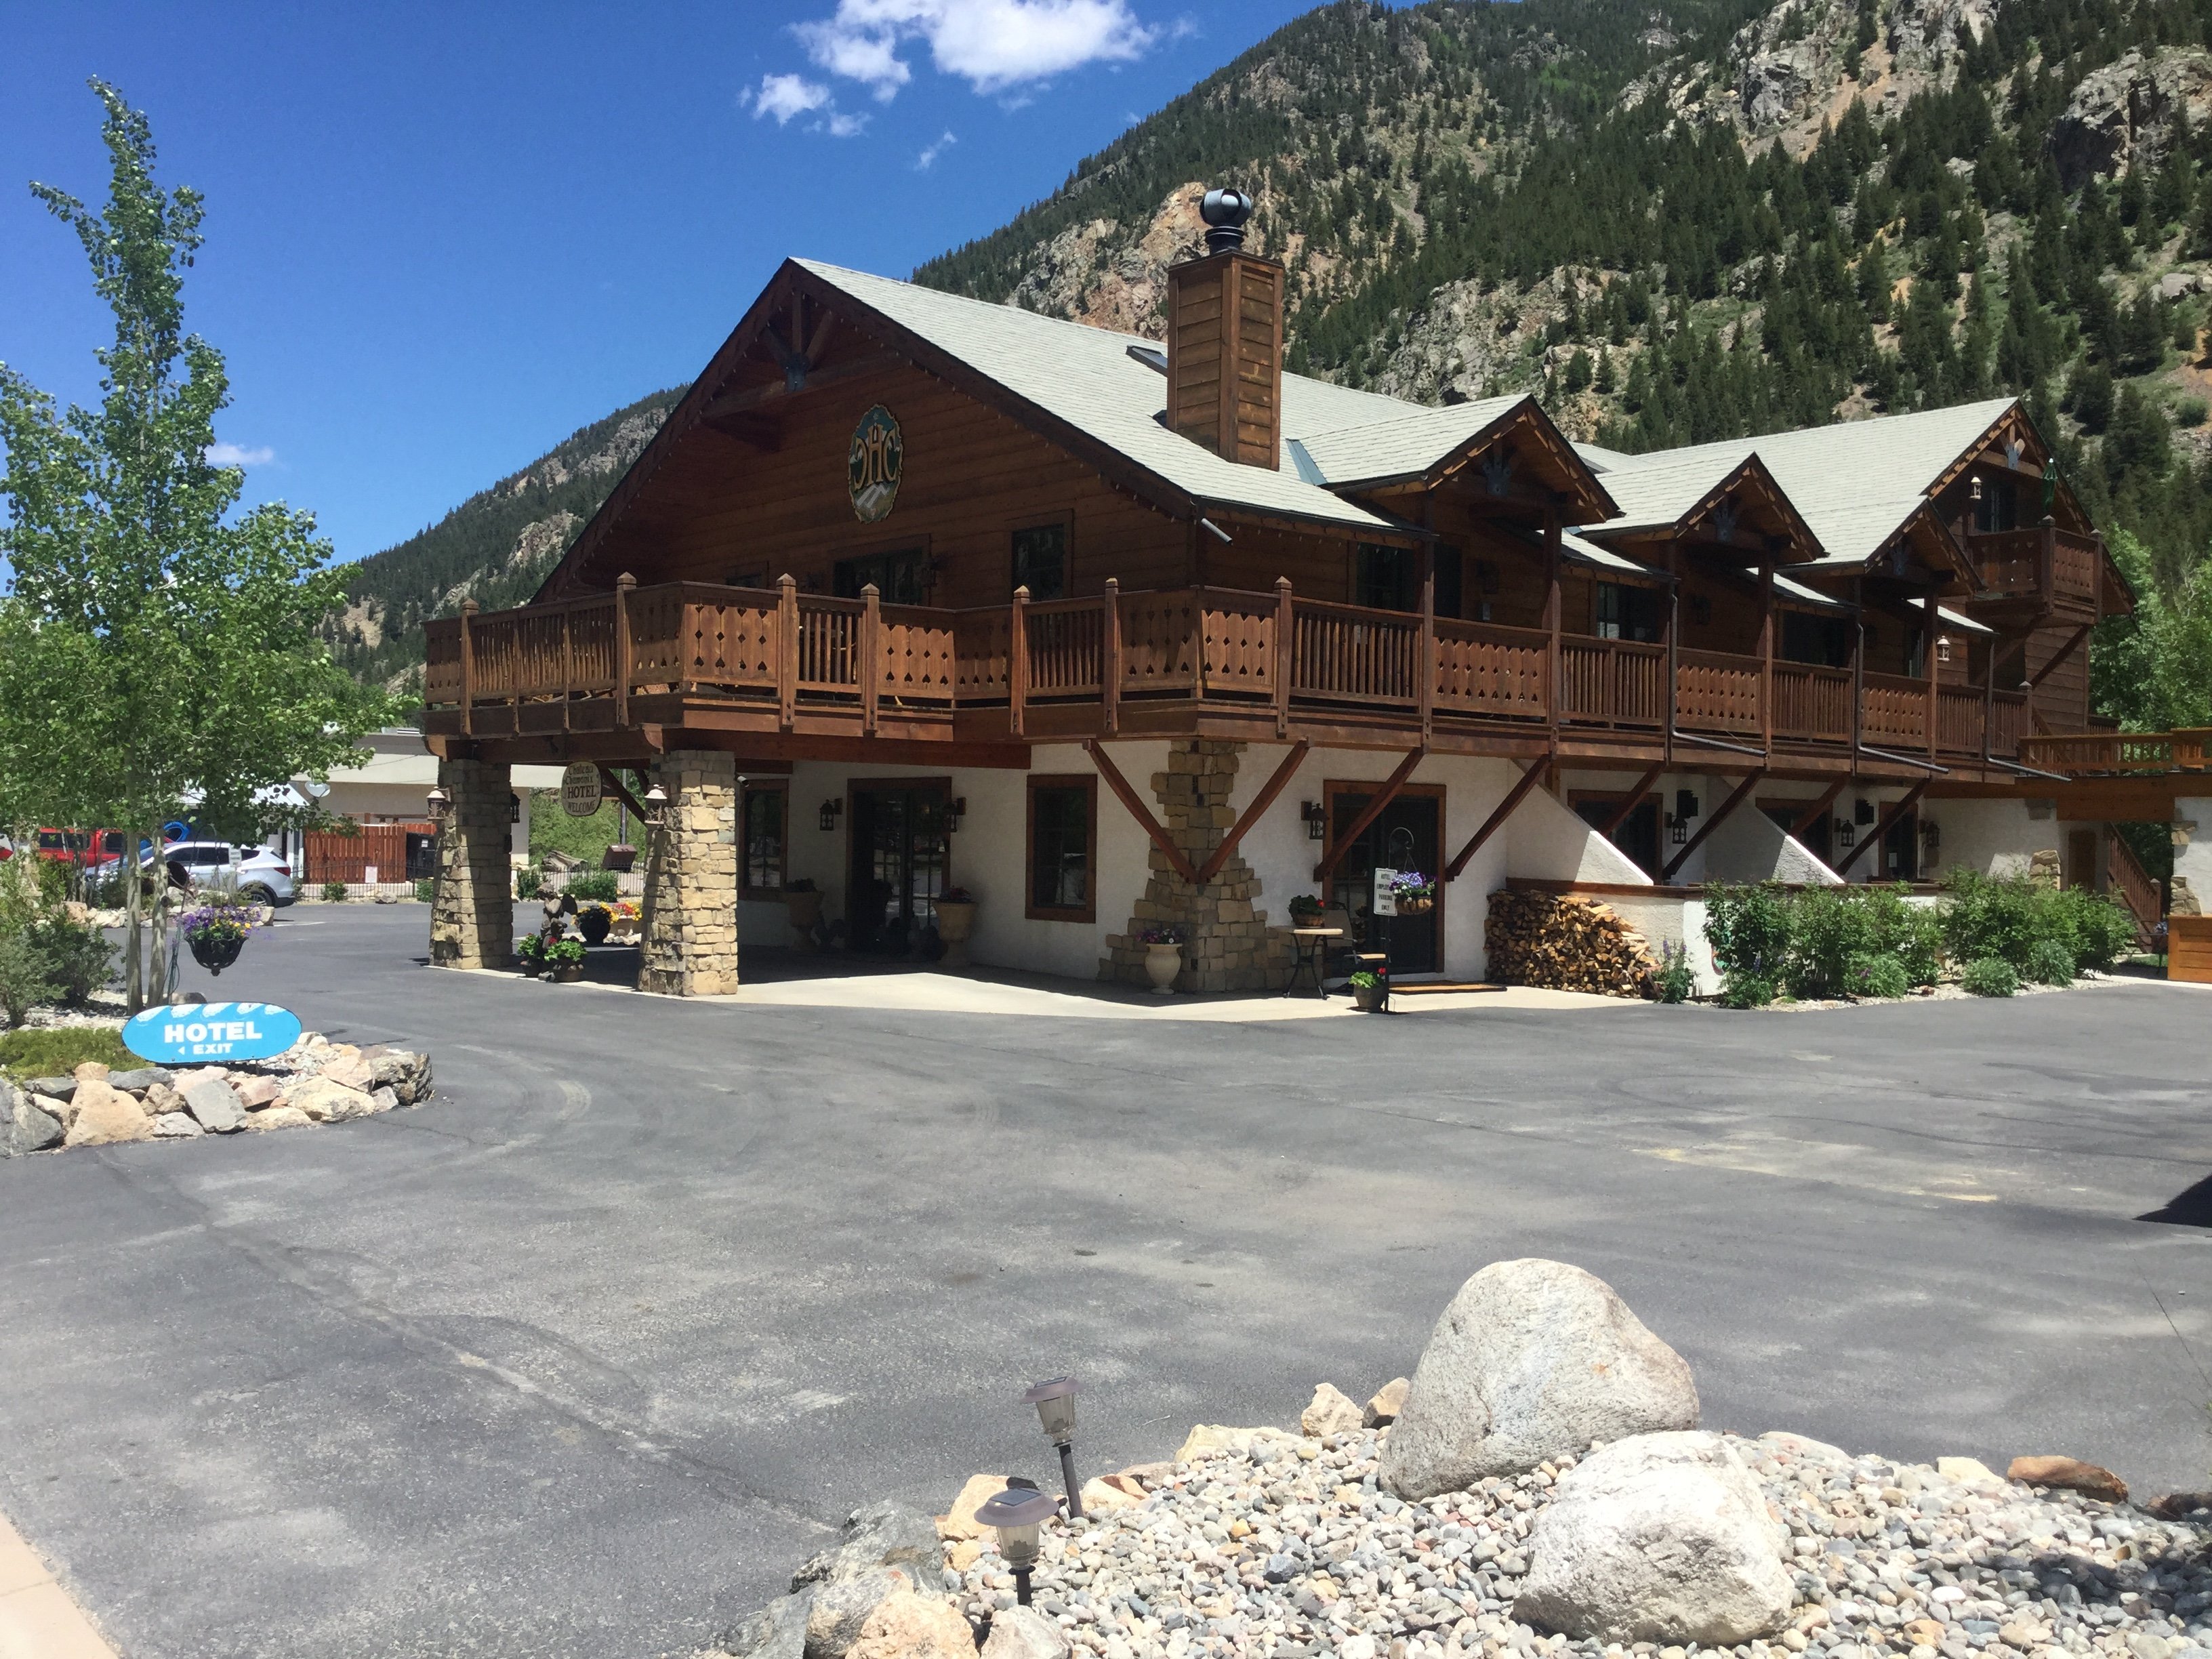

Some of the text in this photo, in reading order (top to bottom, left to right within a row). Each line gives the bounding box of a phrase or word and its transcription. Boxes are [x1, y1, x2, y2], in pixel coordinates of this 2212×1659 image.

[567, 785, 596, 799] HOTEL
[568, 800, 596, 813] WELCOME
[164, 1021, 263, 1044] HOTEL
[192, 1042, 233, 1055] EXIT
